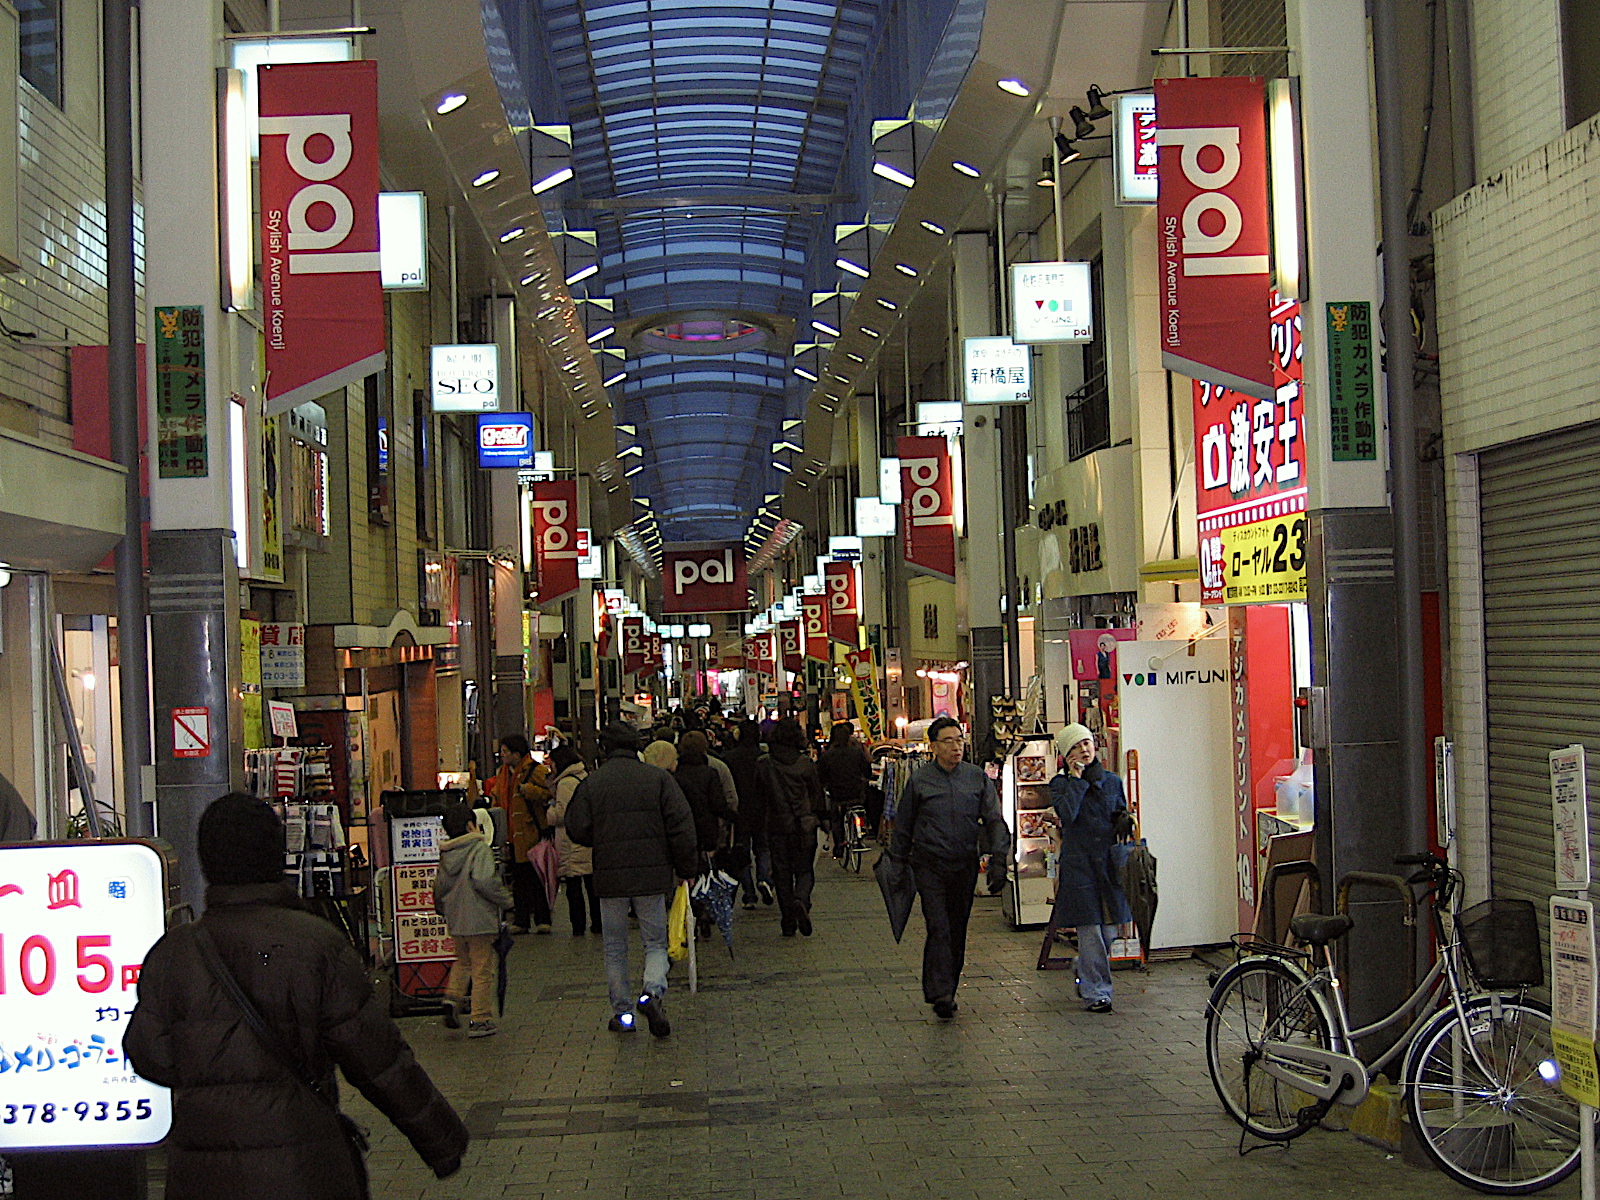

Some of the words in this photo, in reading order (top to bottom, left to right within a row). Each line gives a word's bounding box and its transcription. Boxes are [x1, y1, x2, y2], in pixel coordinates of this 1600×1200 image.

[259, 114, 382, 275] pal
[1155, 126, 1270, 277] pal
[269, 210, 282, 254] Stylish
[1165, 216, 1178, 258] Stylish
[270, 257, 283, 306] Avenue
[400, 268, 422, 283] pal
[1166, 260, 1179, 306] Avenue
[271, 309, 286, 351] Koenji
[1073, 325, 1091, 338] pal
[1168, 308, 1181, 347] Koenji
[437, 378, 494, 395] SEO
[970, 366, 1026, 384] 新橋屋
[1350, 304, 1372, 459] 防犯カメラ作動中
[483, 398, 498, 410] pal
[1015, 389, 1031, 400] pal
[900, 456, 954, 527] pal
[531, 499, 579, 559] pal
[674, 548, 734, 595] pal
[826, 574, 857, 616] pal
[804, 604, 828, 638] pal
[624, 625, 644, 654] pal
[744, 643, 758, 660] pal
[755, 639, 772, 660] pal
[780, 628, 801, 655] pal
[1167, 669, 1228, 685] MIFUN
[0, 1098, 152, 1124] 378-9355
